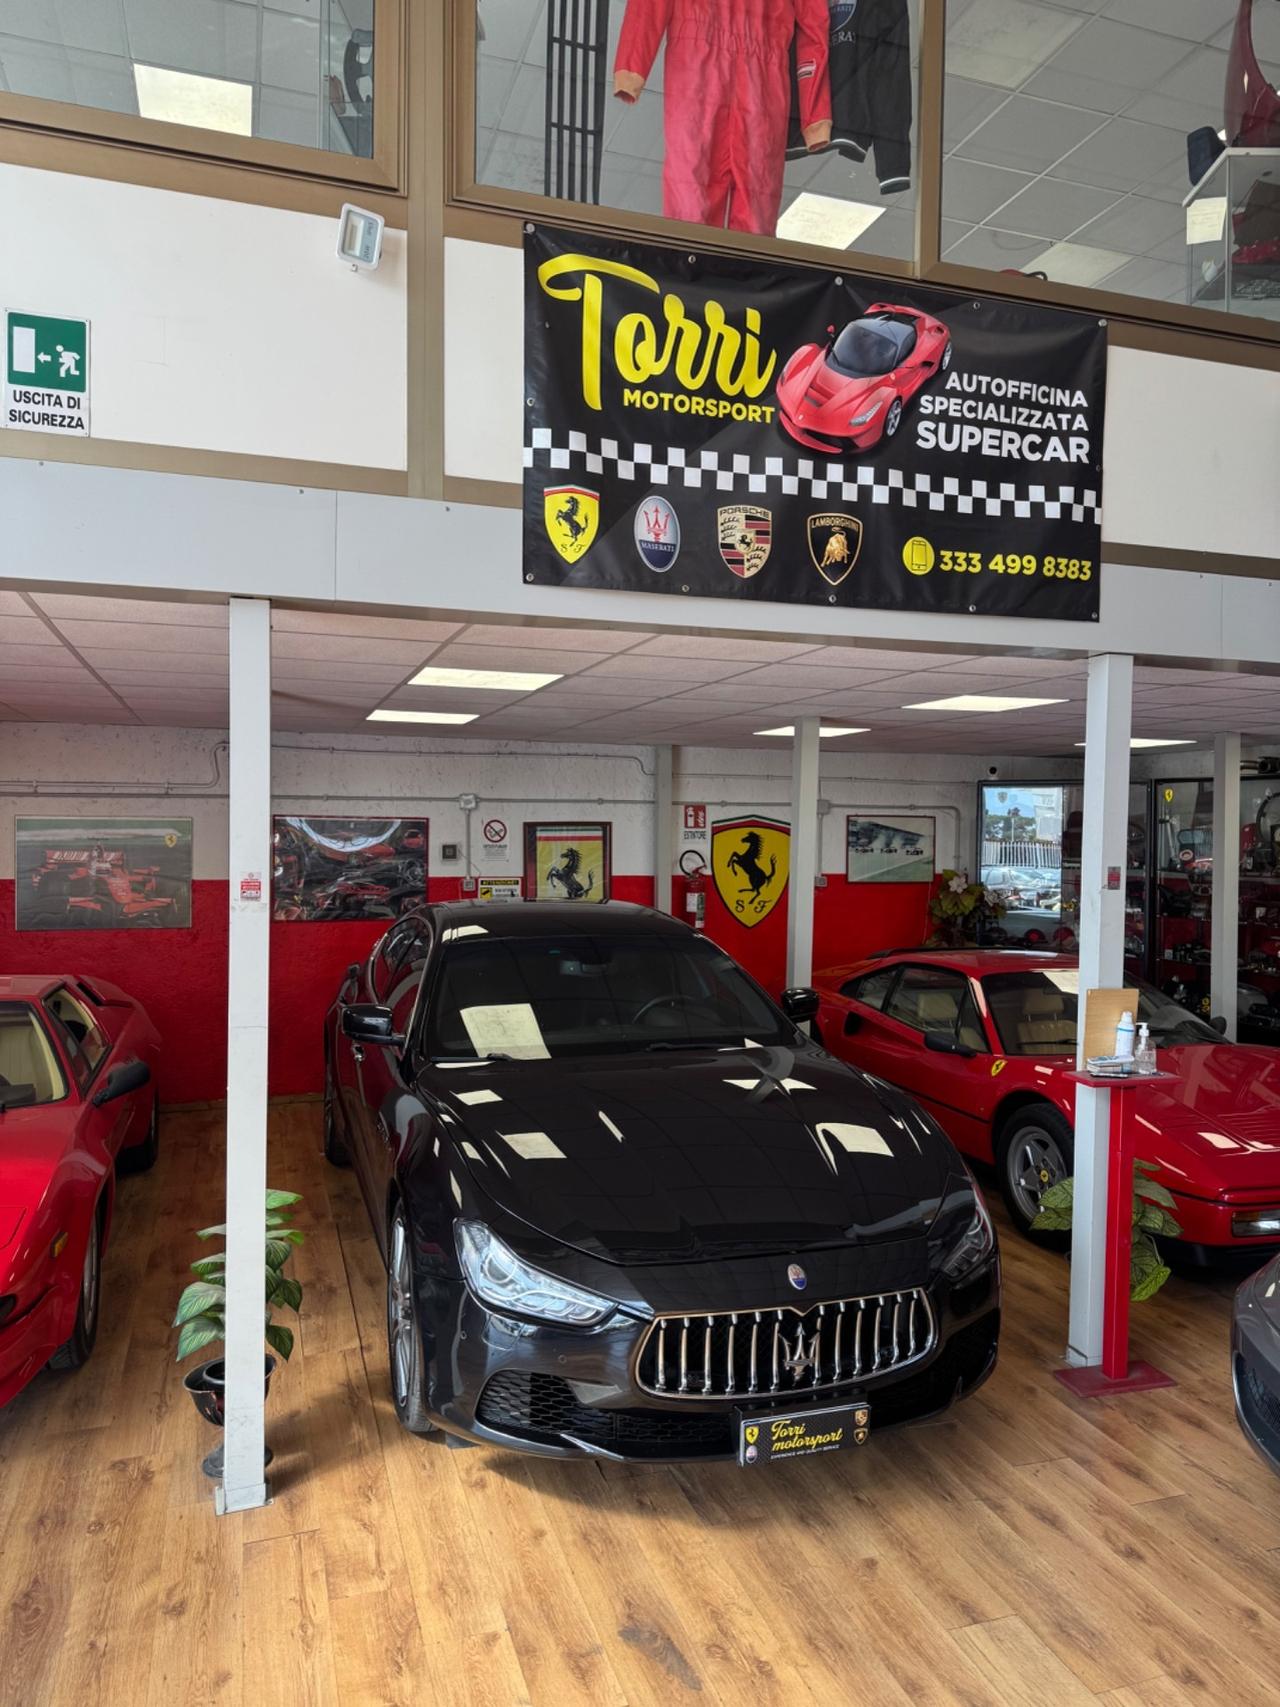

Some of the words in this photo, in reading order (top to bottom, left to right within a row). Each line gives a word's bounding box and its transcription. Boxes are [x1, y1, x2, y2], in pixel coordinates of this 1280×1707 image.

[537, 253, 777, 411] Torri
[13, 389, 63, 408] USCITA
[66, 395, 81, 410] DI
[945, 371, 1088, 408] AUTOFFICINA
[9, 408, 85, 430] SICUREZZA
[622, 388, 775, 424] MOTORSPORT
[919, 394, 1089, 431] SPECIALIZZATA
[916, 420, 1090, 464] SUPERCAR
[719, 506, 770, 519] PORSCHE
[640, 542, 675, 553] MASERATI
[939, 550, 982, 573] 333
[988, 553, 1037, 576] 499
[1042, 556, 1092, 581] 8383
[771, 1420, 806, 1441] Torri
[772, 1428, 843, 1452] motorsport
